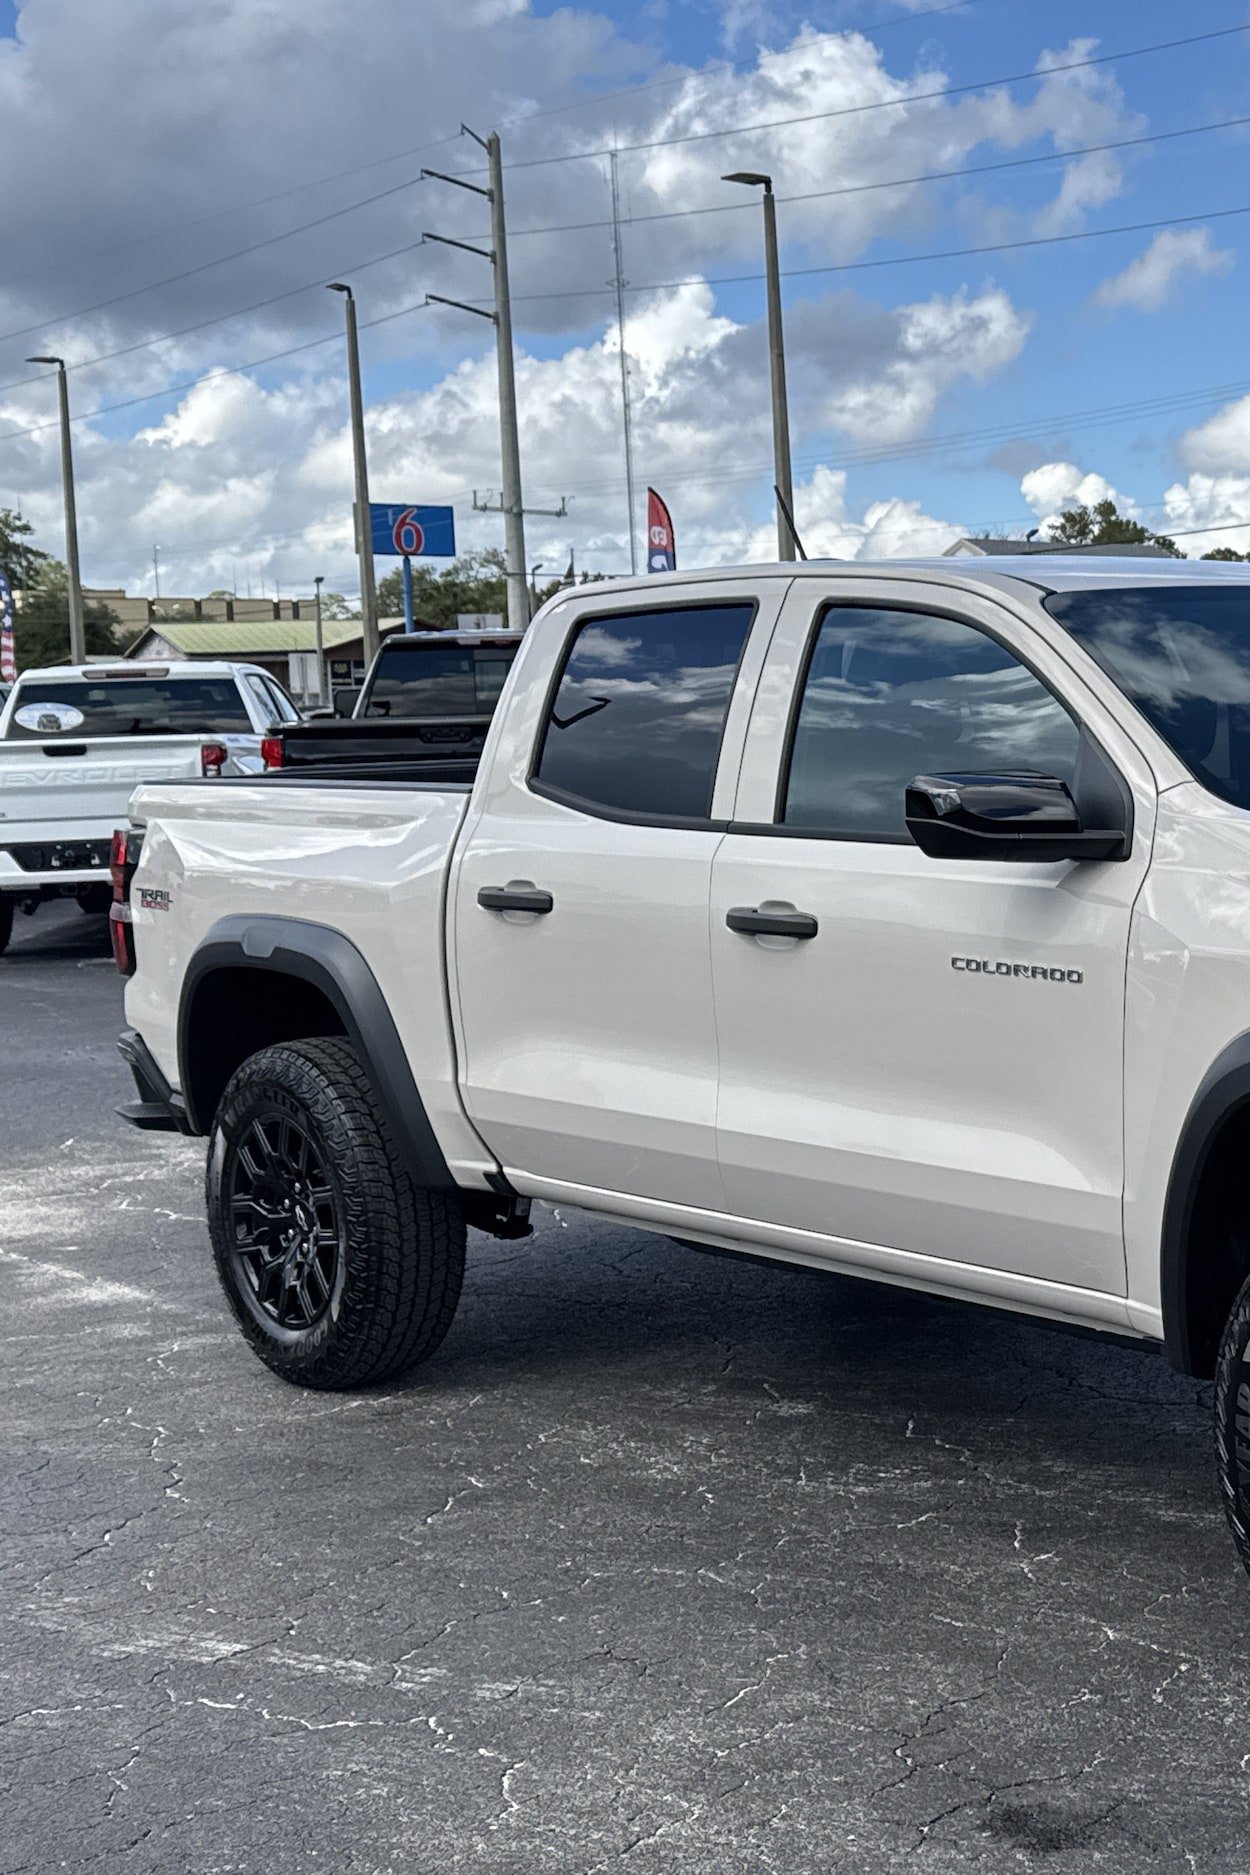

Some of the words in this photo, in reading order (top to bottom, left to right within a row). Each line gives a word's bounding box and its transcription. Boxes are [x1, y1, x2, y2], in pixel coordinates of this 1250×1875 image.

[393, 507, 425, 554] 6
[135, 887, 173, 903] TRAIL
[141, 899, 169, 912] BOSS
[951, 957, 1083, 984] COLORADO
